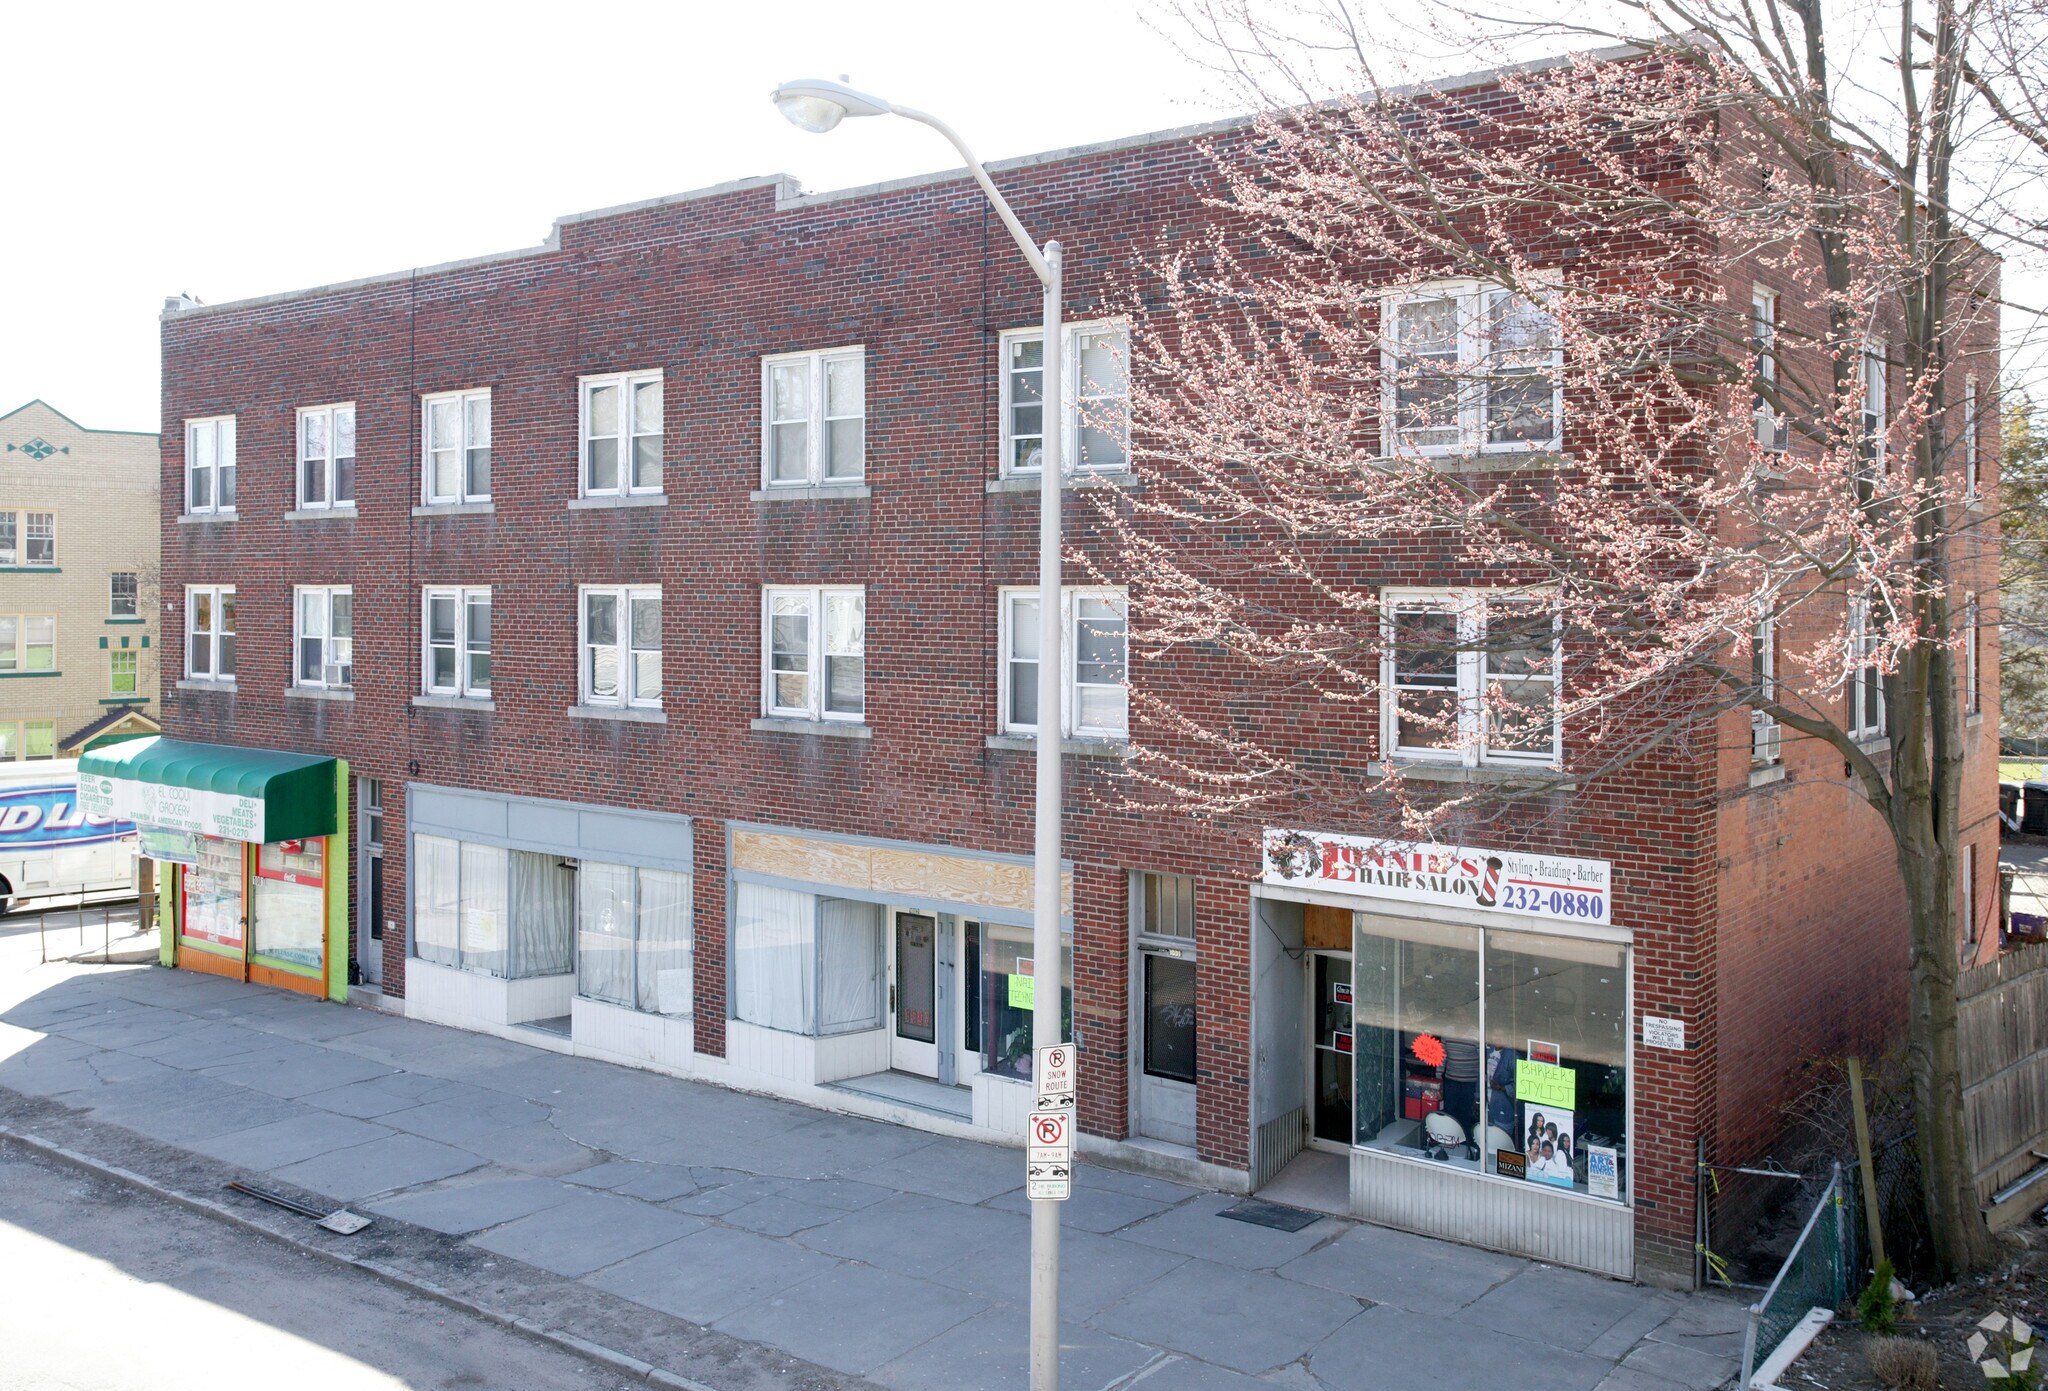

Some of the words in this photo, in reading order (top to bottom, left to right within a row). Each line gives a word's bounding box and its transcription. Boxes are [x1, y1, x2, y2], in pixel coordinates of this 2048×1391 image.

[81, 774, 96, 783] BEER
[80, 783, 98, 794] SODAS
[158, 786, 166, 798] EL
[169, 788, 191, 802] COQUI
[80, 792, 114, 806] CIGARETTES
[158, 801, 191, 817] GROCERY
[130, 811, 150, 822] SPANISH
[158, 817, 182, 827] AMERICAN
[184, 820, 202, 830] FOODS
[219, 825, 249, 838] 231-0270
[1507, 857, 1534, 881] Styling
[1539, 860, 1571, 885] Braiding
[1577, 864, 1603, 883] Barber
[1360, 866, 1410, 888] HAIR
[1415, 873, 1480, 896] SALON
[1502, 885, 1603, 919] 232-0880
[1645, 1022, 1682, 1032] TRESPASSING
[1649, 1030, 1679, 1039] VIOLATORS
[1646, 1039, 1682, 1049] PROSECUTED
[1047, 1070, 1067, 1080] SNOW
[1521, 1061, 1574, 1084] BARBERS
[1045, 1081, 1068, 1091] ROUTE
[1518, 1079, 1575, 1103] STYLIST
[1590, 1154, 1610, 1166] ART
[1498, 1162, 1524, 1174] MIZANI
[1590, 1163, 1614, 1173] MUSIC
[1031, 1182, 1037, 1190] 2
